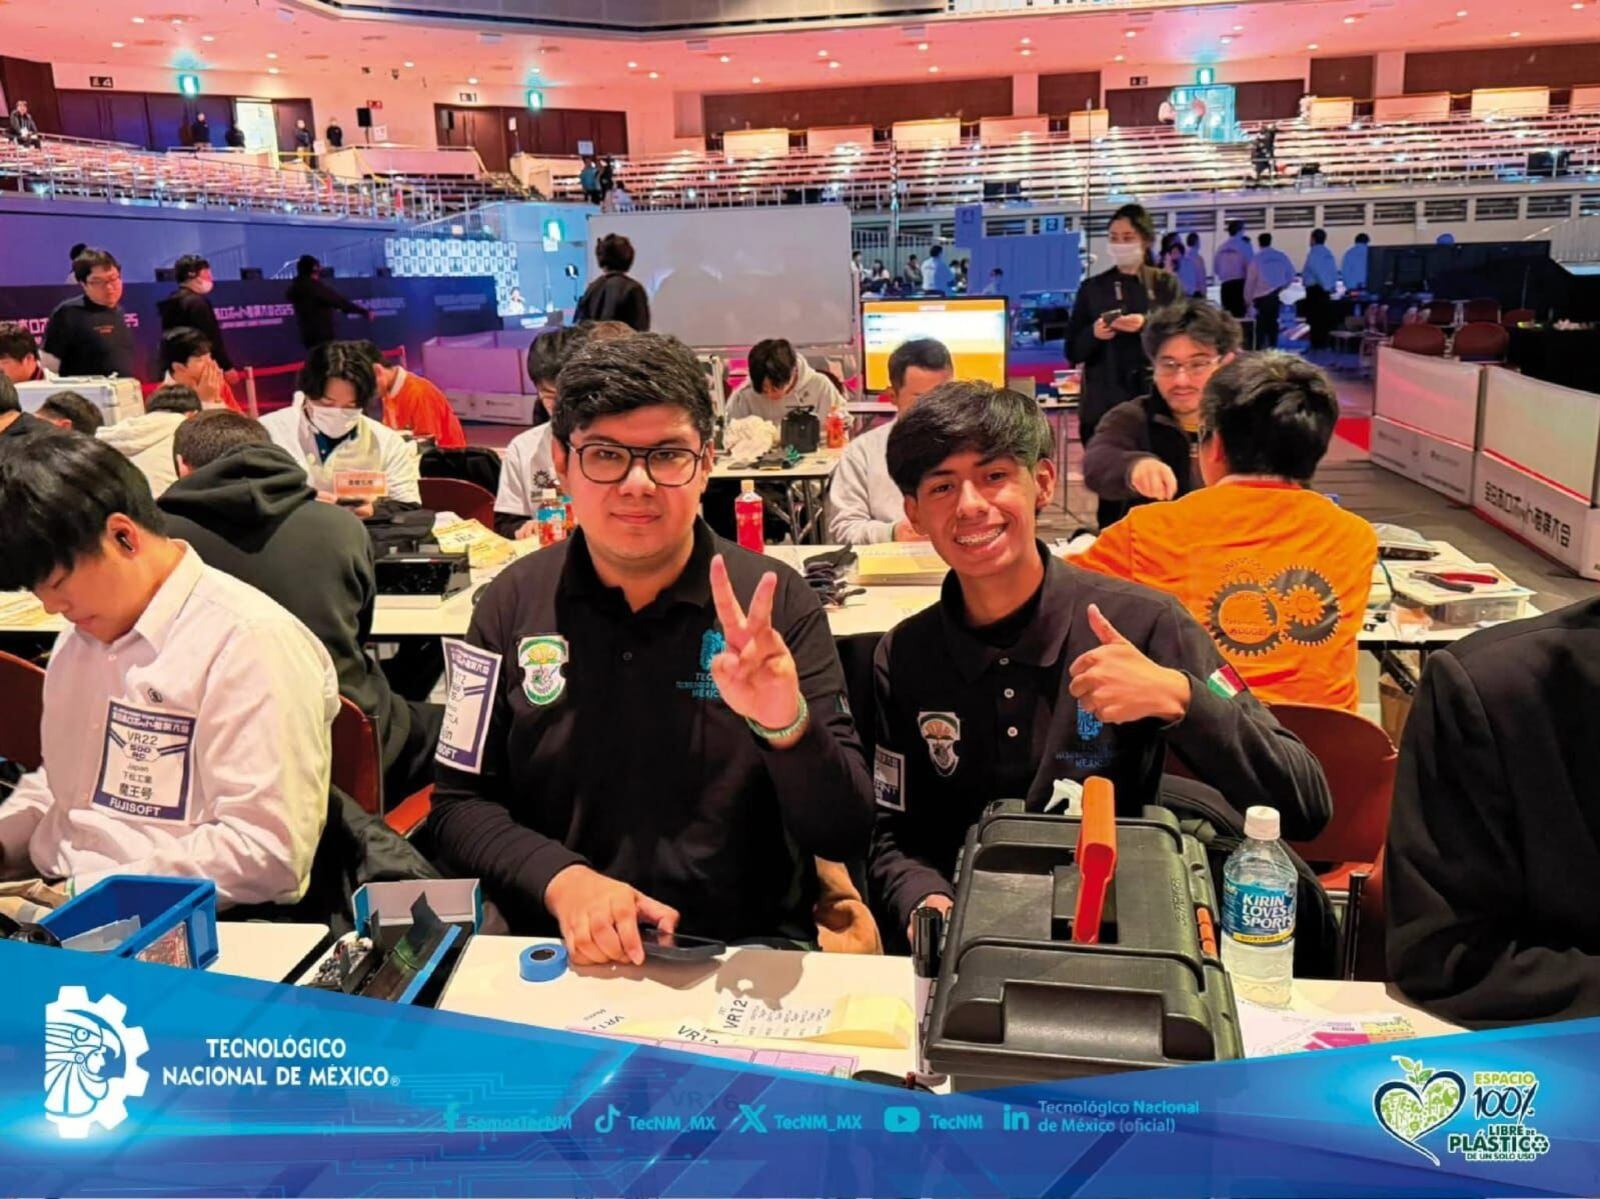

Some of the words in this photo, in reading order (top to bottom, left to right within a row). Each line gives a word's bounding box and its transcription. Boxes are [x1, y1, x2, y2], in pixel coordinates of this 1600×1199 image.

[127, 730, 159, 746] VR22
[109, 797, 162, 817] FUJISOFT
[1242, 893, 1285, 907] KIRIN
[1241, 904, 1288, 918] LOVES
[591, 1014, 625, 1030] VR1
[722, 999, 749, 1029] VR12
